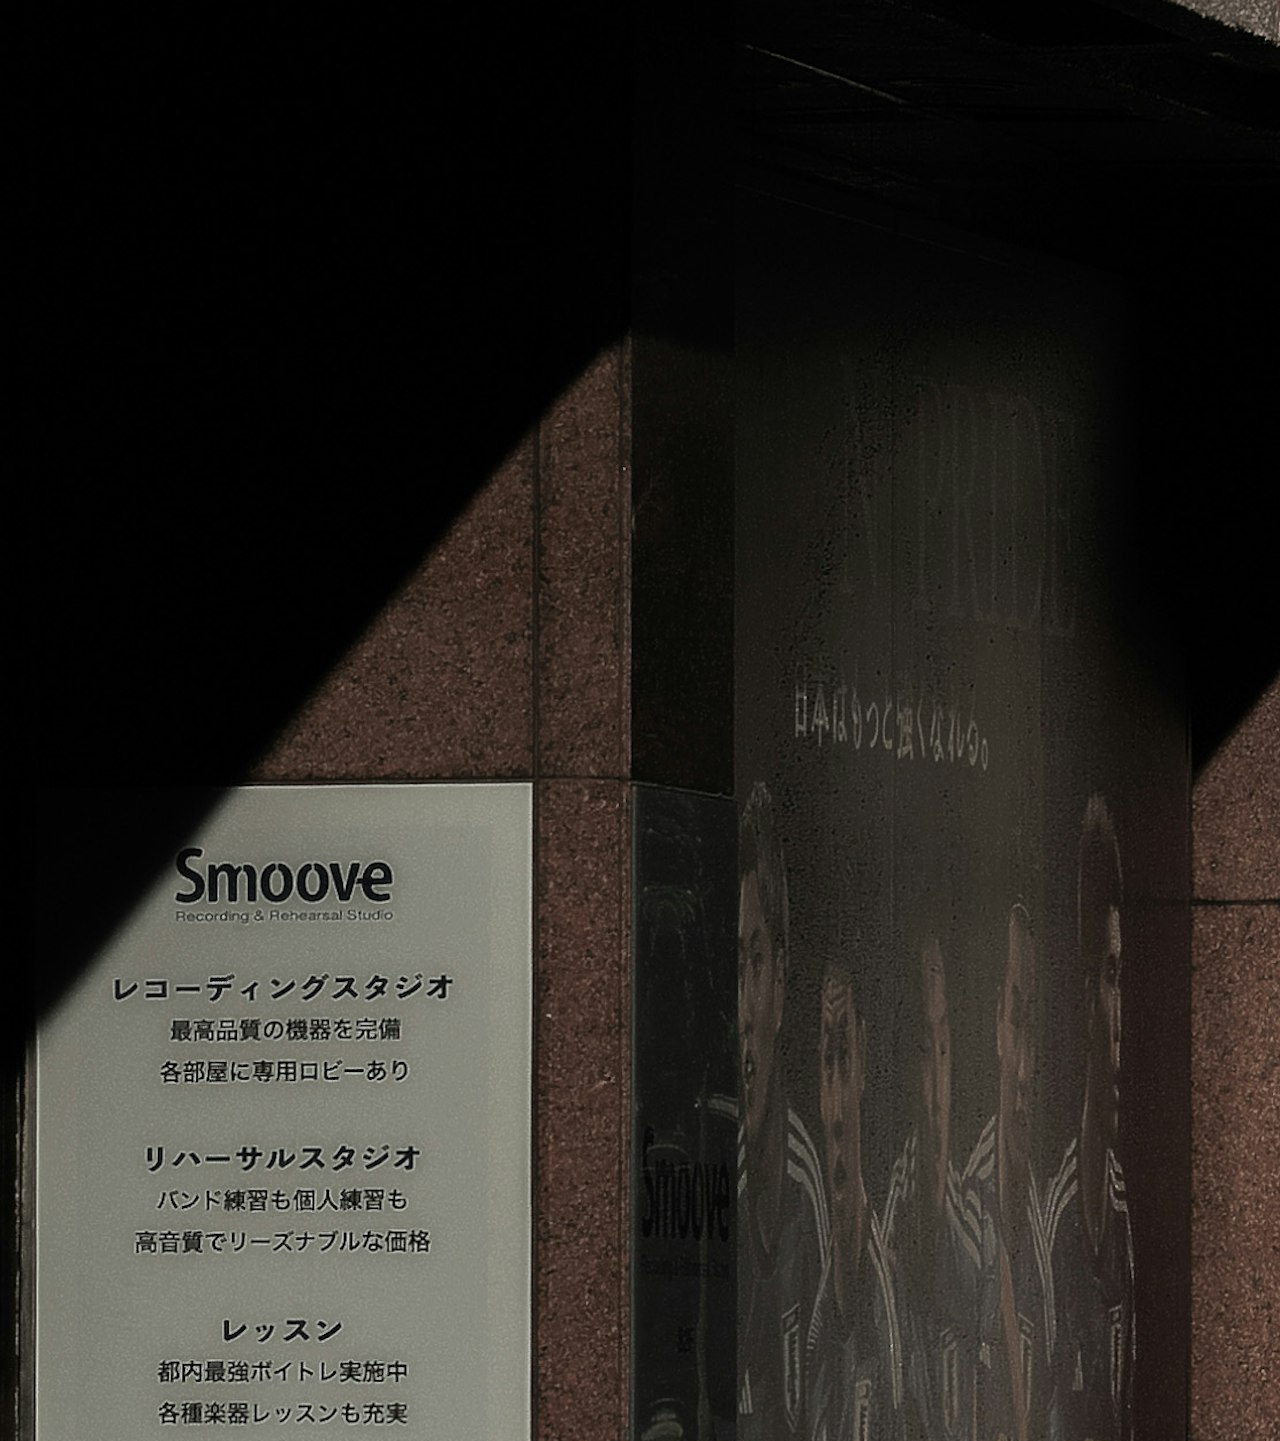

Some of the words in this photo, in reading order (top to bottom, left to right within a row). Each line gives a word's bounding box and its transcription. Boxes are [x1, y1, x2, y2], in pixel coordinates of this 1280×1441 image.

[174, 847, 394, 904] Smoove
[176, 910, 250, 924] Recording
[253, 910, 265, 922] &
[269, 909, 344, 922] Rehearsal
[347, 909, 394, 922] Studio
[113, 974, 454, 1001] レコーディングスタジオ
[170, 1019, 402, 1042] 最高品質の機器を完備
[160, 1060, 410, 1084] 各部屋に専用ロビーあり
[145, 1145, 421, 1171] リハーサルスタジオ
[641, 1125, 730, 1242] Smoove
[157, 1189, 408, 1212] バンド練習も個人練習も
[135, 1229, 432, 1254] 高音質でリーズナブルな価格
[222, 1319, 343, 1343] レッスン
[158, 1360, 409, 1383] 都内最強ボイトレ実施中
[158, 1401, 409, 1424] 各種楽器レッスンも充実
